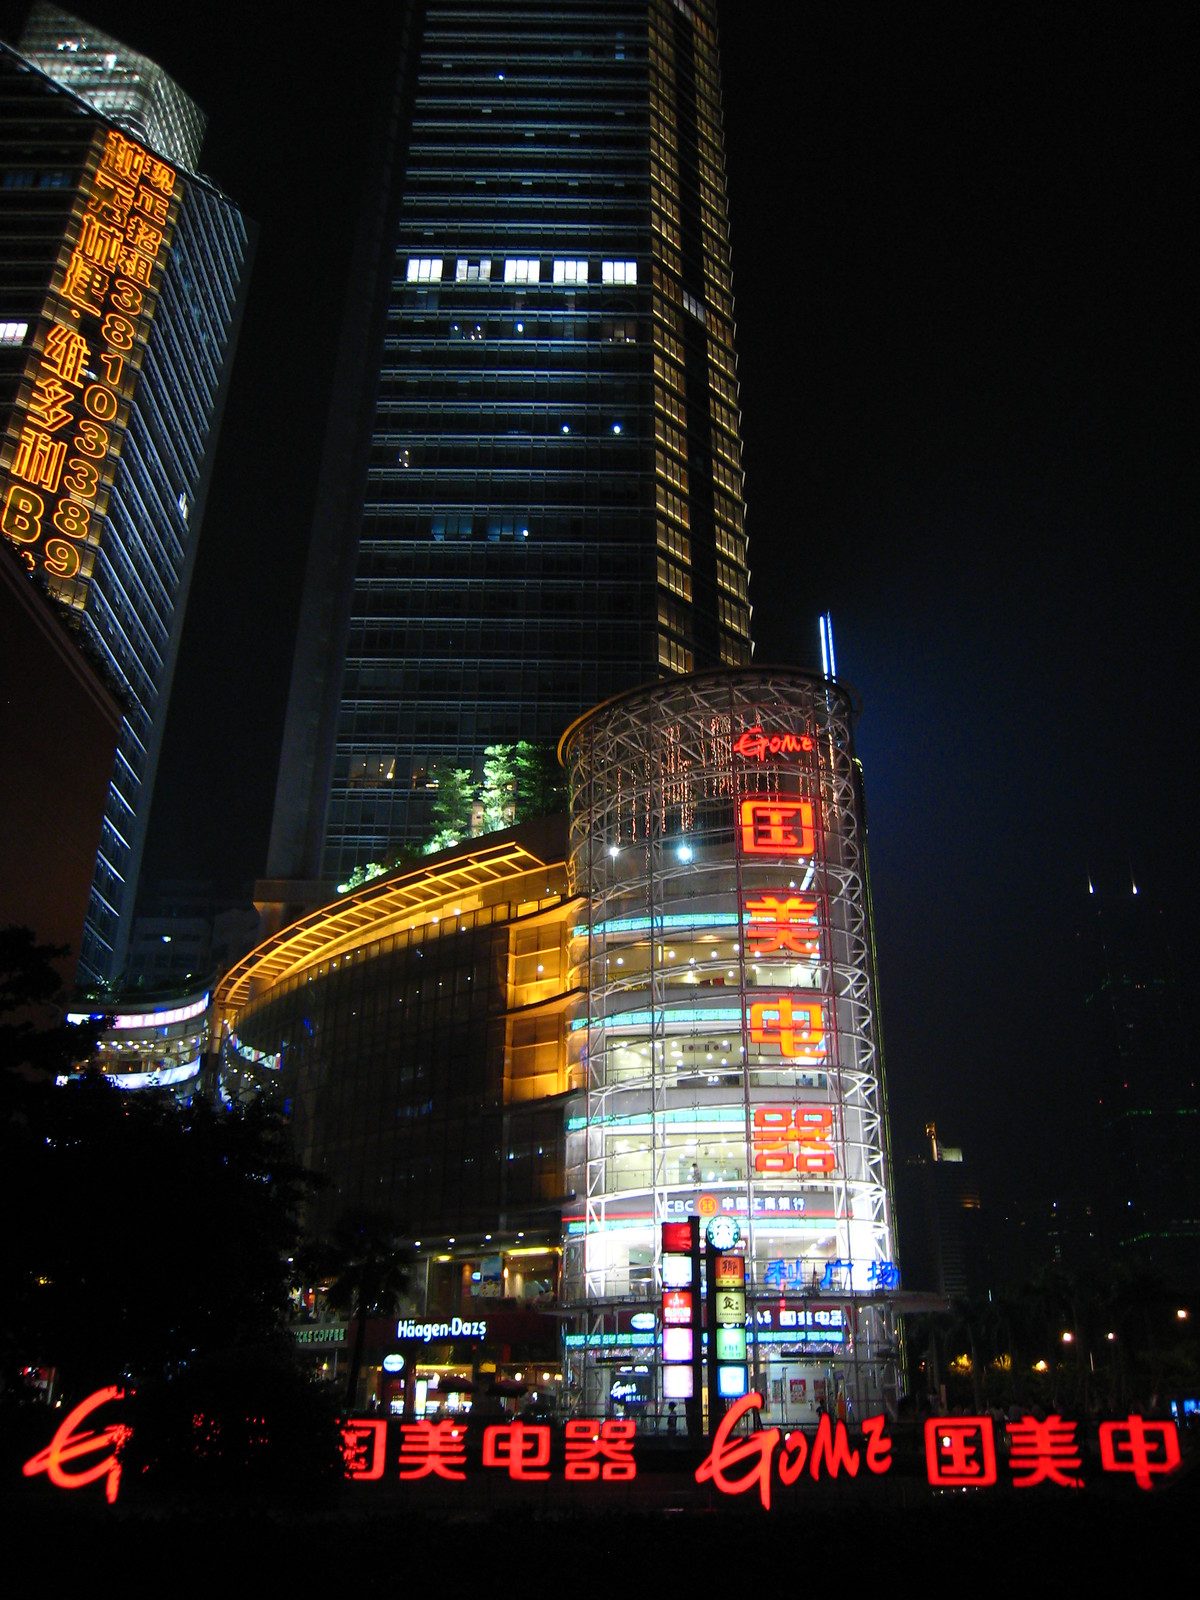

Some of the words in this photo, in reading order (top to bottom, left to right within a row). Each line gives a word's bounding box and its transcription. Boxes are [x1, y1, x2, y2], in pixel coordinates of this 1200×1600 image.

[740, 800, 835, 1173] 国美电器
[722, 1196, 806, 1212] 中国工商银行
